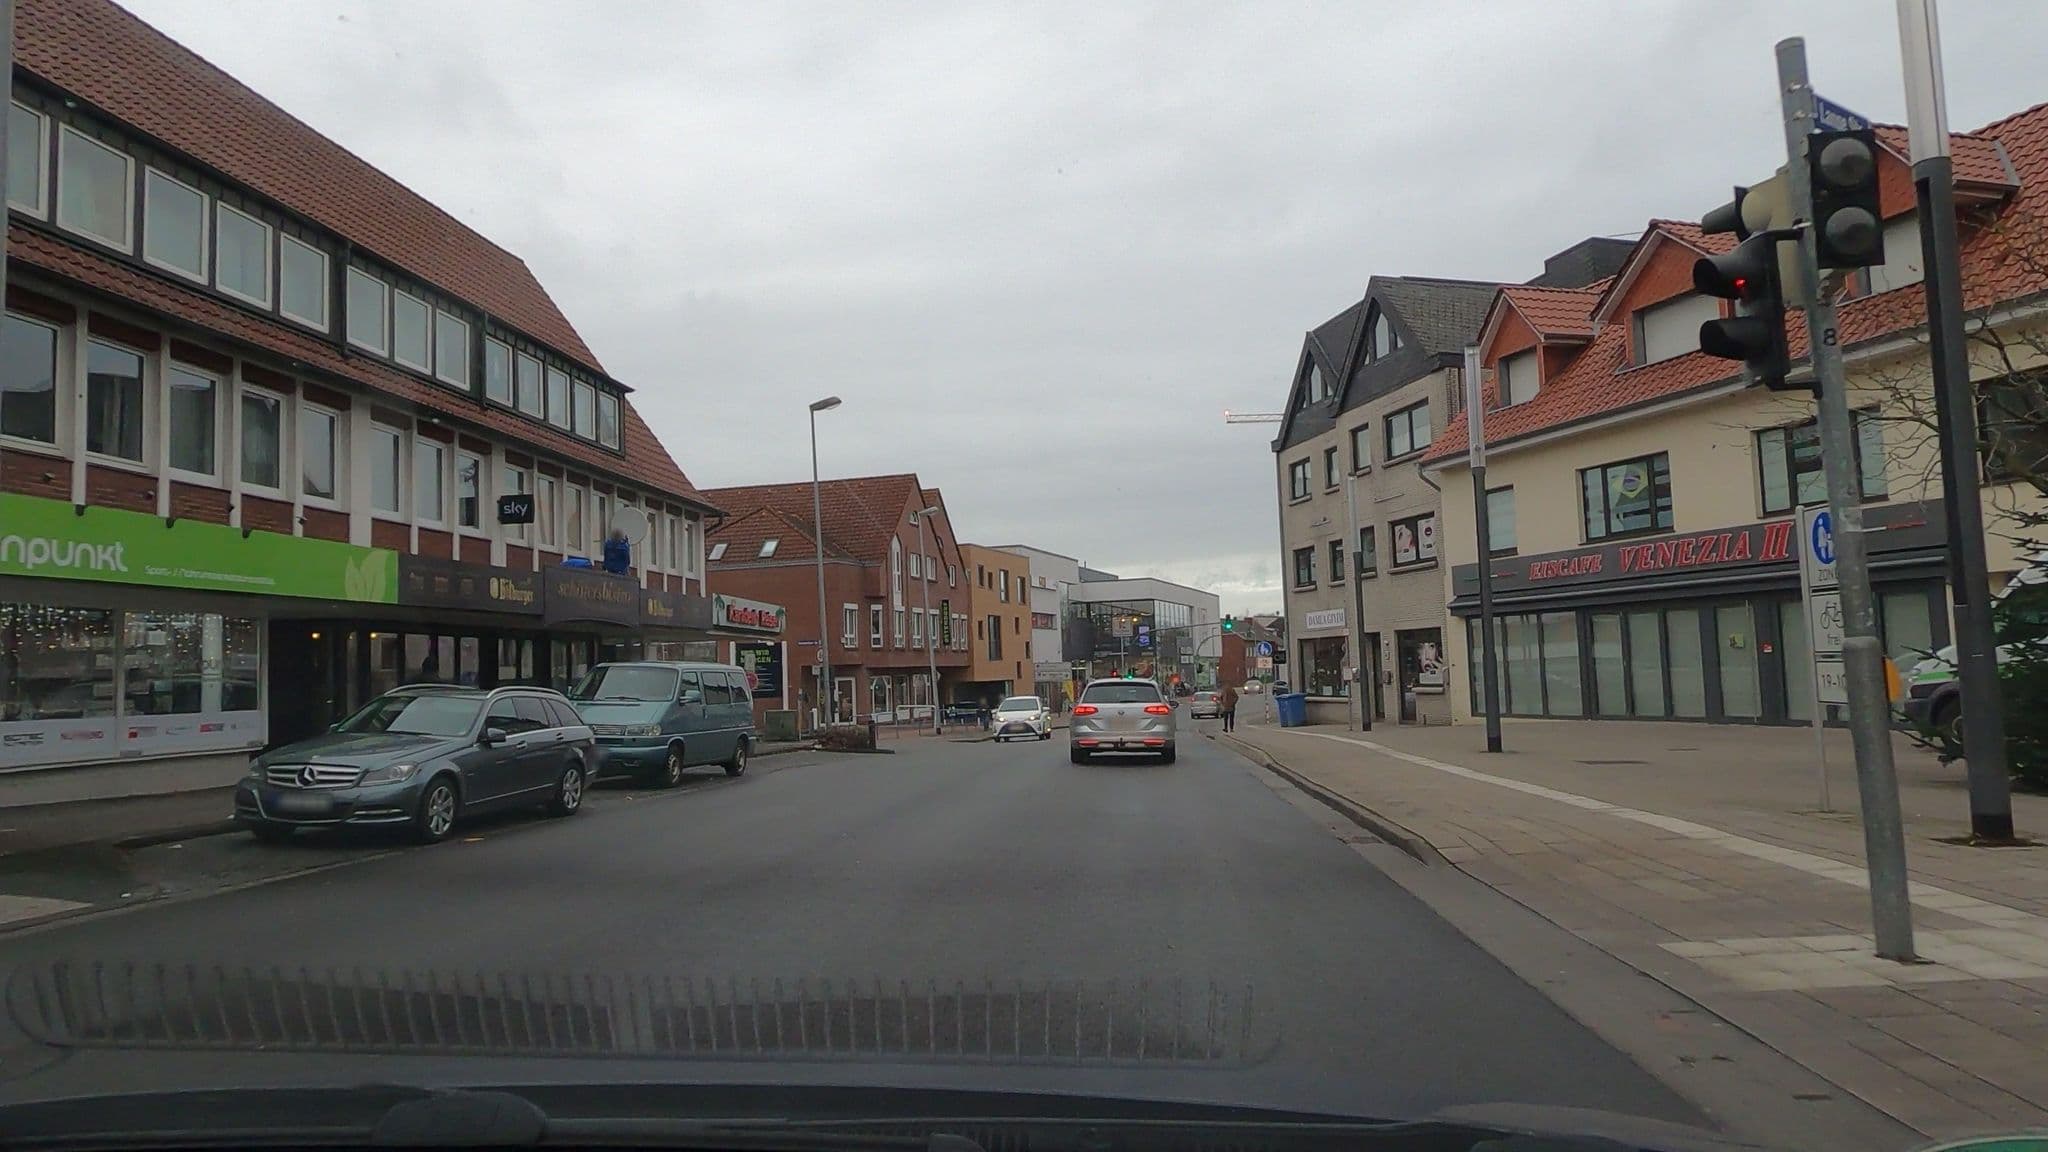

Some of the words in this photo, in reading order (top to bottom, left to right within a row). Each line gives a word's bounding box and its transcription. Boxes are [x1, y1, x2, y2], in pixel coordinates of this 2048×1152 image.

[1823, 327, 1837, 346] 8
[503, 501, 528, 517] sky
[1529, 554, 1602, 580] EISCAFE
[1619, 531, 1752, 573] VENEZIA
